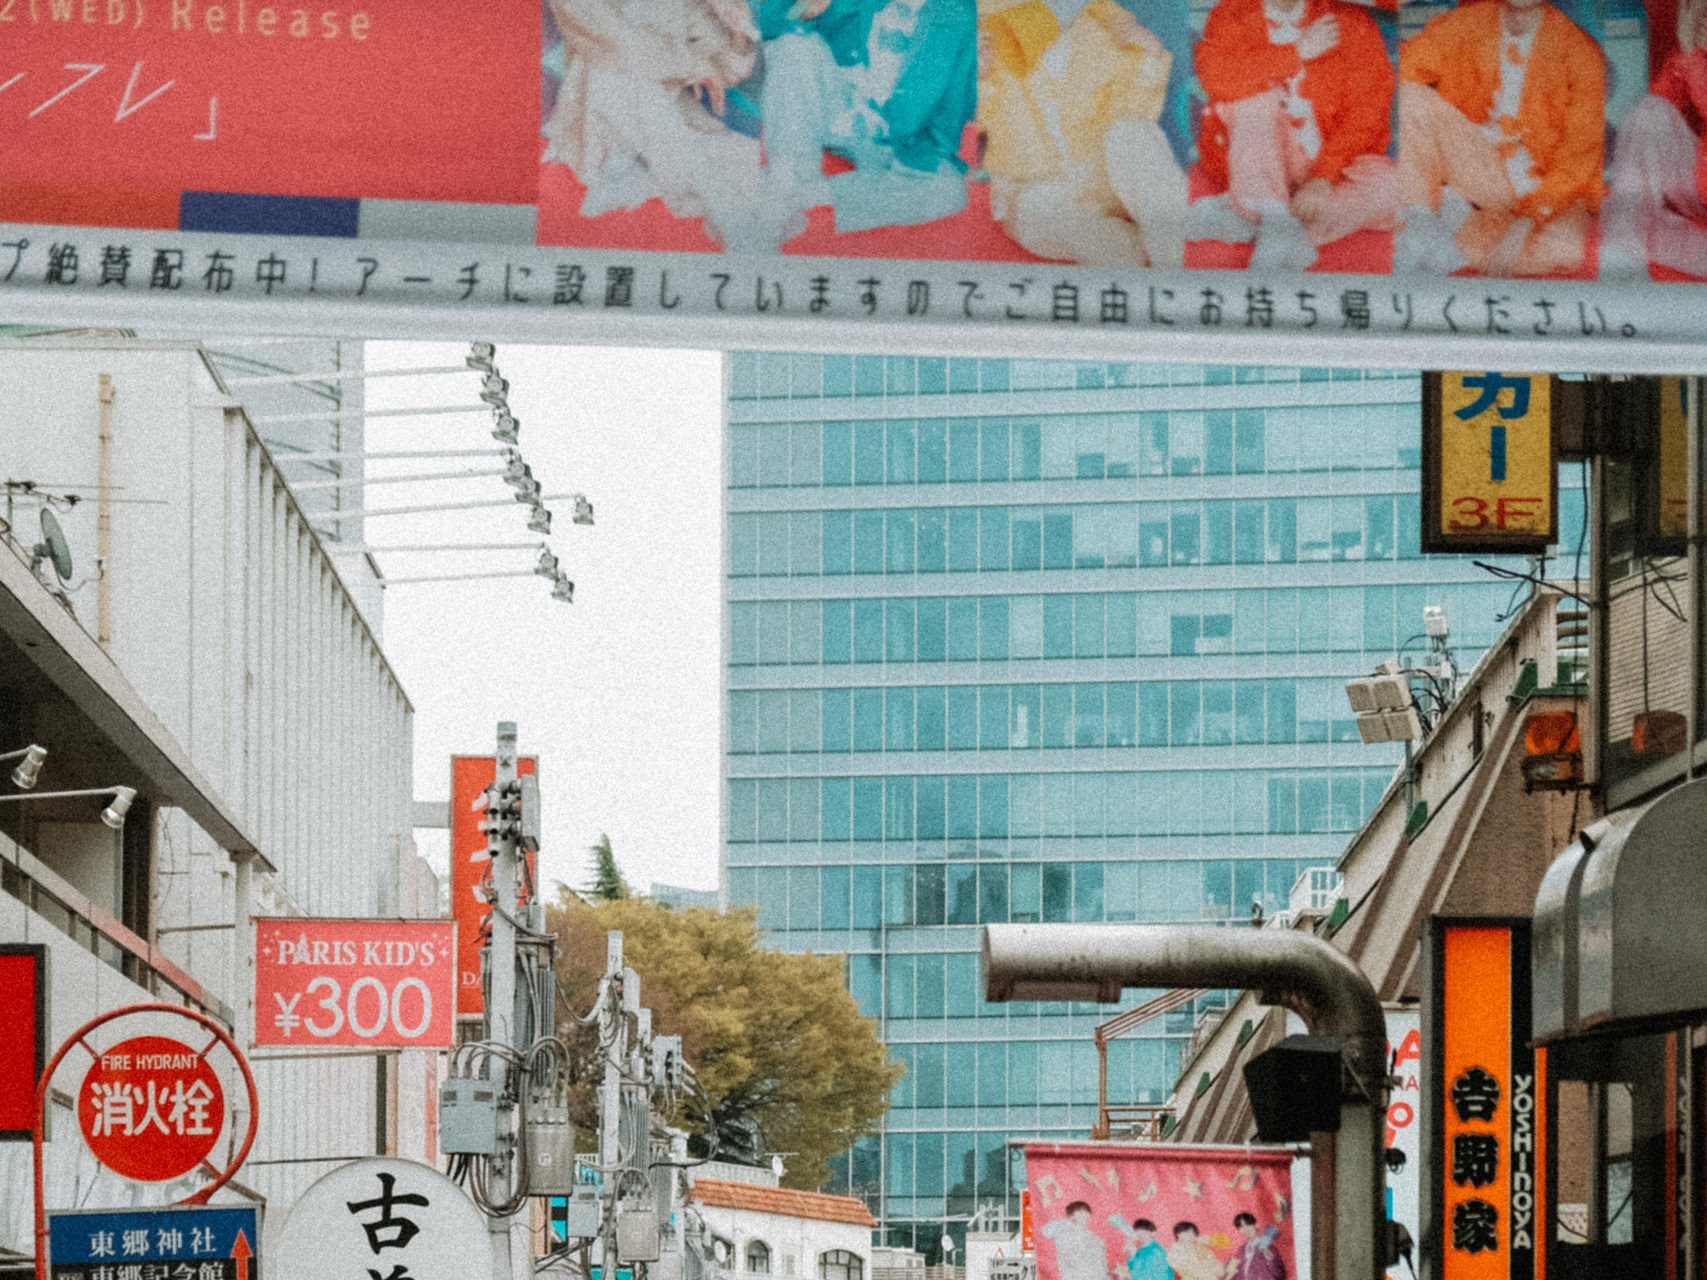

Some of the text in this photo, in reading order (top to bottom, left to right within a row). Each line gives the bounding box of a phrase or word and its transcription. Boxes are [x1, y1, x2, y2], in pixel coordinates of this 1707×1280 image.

[171, 0, 371, 40] Release
[1449, 496, 1543, 528] 3F
[278, 932, 435, 966] PARIS KID'S
[273, 975, 433, 1038] ¥300
[101, 1054, 198, 1070] FIRE HYDRANT
[91, 1080, 214, 1137] 消火栓
[1450, 1065, 1500, 1255] 吉野家
[1513, 1074, 1533, 1250] YOSHINOYA
[88, 1226, 217, 1258] 東郷神社
